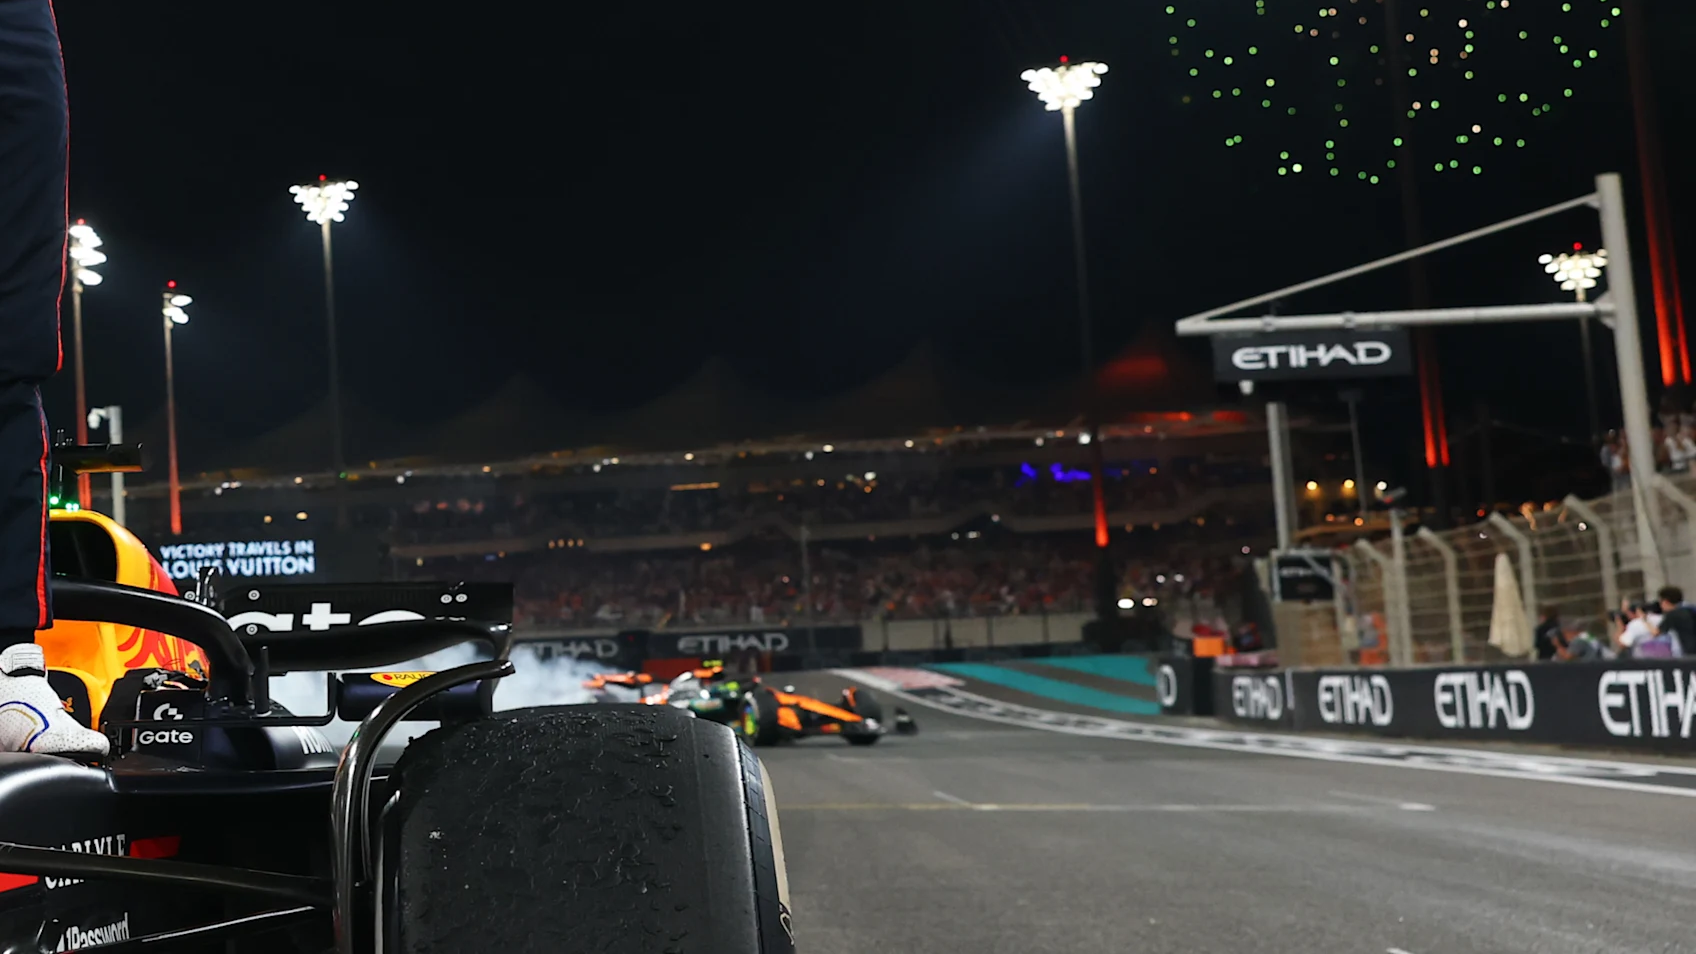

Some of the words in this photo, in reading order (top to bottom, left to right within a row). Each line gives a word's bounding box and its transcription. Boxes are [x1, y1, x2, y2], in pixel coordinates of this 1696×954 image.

[1231, 341, 1392, 370] ETIHAD
[160, 542, 225, 560] VICTORY
[227, 540, 292, 557] TRAVELS
[294, 539, 314, 555] IN
[225, 555, 315, 576] VUITTON
[518, 640, 619, 659] TIHAD
[677, 632, 789, 655] ETIHAD
[1232, 676, 1283, 720] ETIHAD
[1318, 675, 1393, 726] ETIHAD
[1434, 670, 1535, 730] ETIHAD
[139, 729, 194, 745] Gate
[66, 912, 130, 951] 1Password
